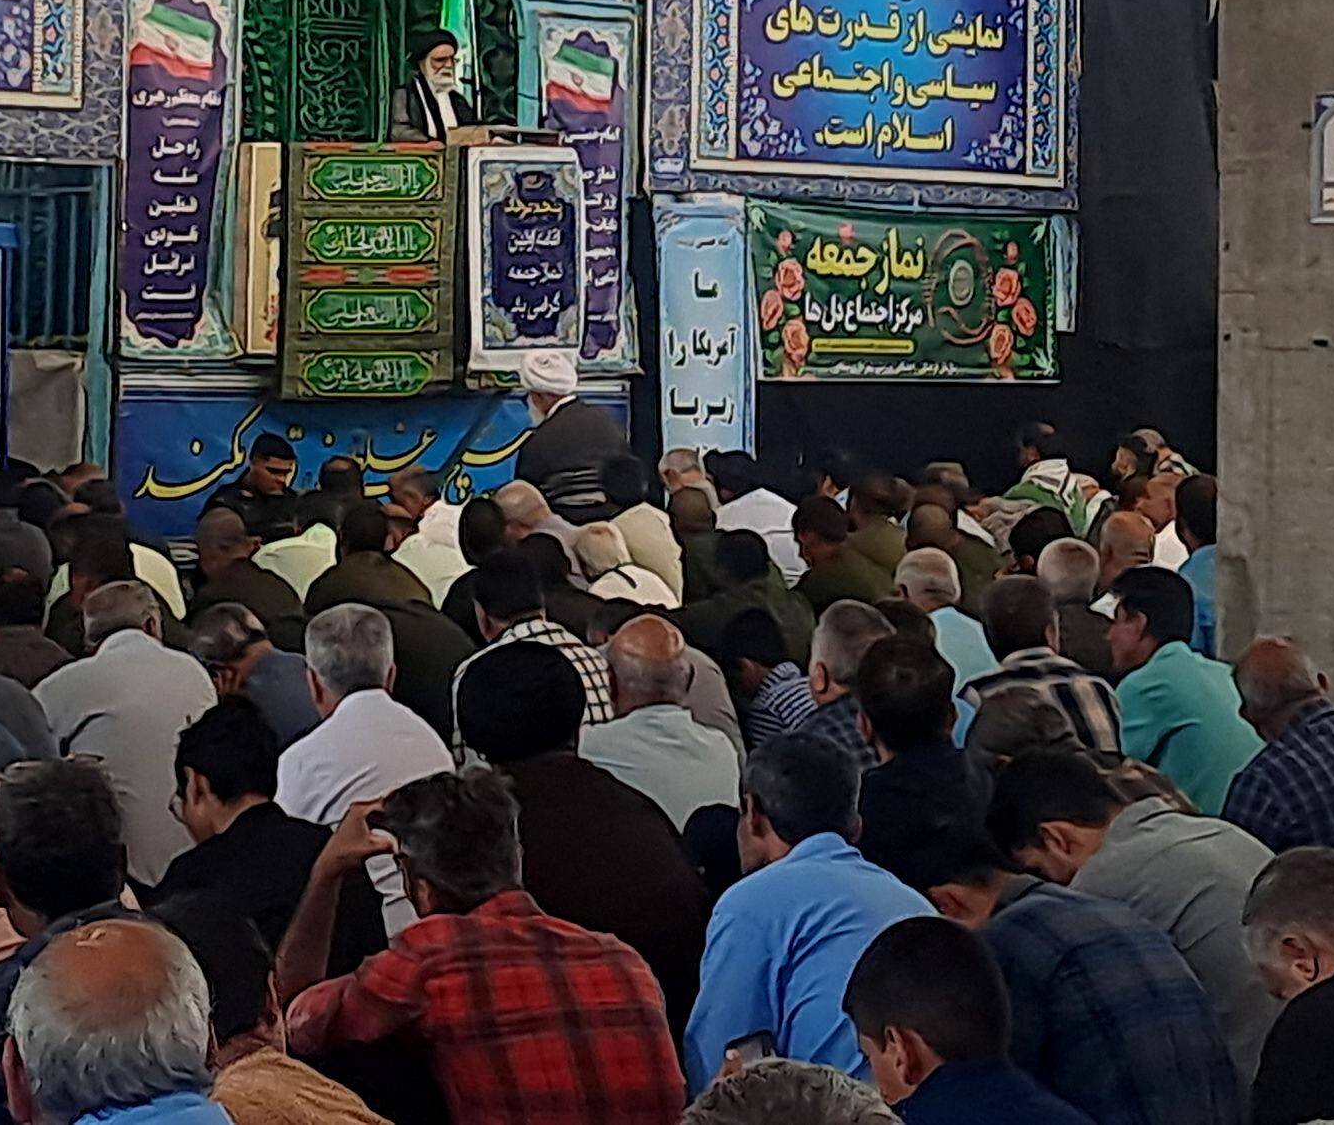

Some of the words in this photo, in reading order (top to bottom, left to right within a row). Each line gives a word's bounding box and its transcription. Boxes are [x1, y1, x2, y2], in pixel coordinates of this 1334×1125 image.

[902, 8, 925, 56] از
[927, 13, 1007, 57] نمایشی
[771, 54, 892, 103] اجتماعی
[890, 80, 906, 107] و
[904, 63, 998, 110] سیاسی
[874, 111, 955, 160] اسلام
[805, 235, 879, 290] جمعه
[874, 226, 926, 295] نماز
[693, 270, 719, 299] ما
[843, 293, 895, 333] اجتماع
[889, 295, 924, 334] مرکز
[668, 328, 687, 367] را
[692, 326, 737, 367] آمریکا
